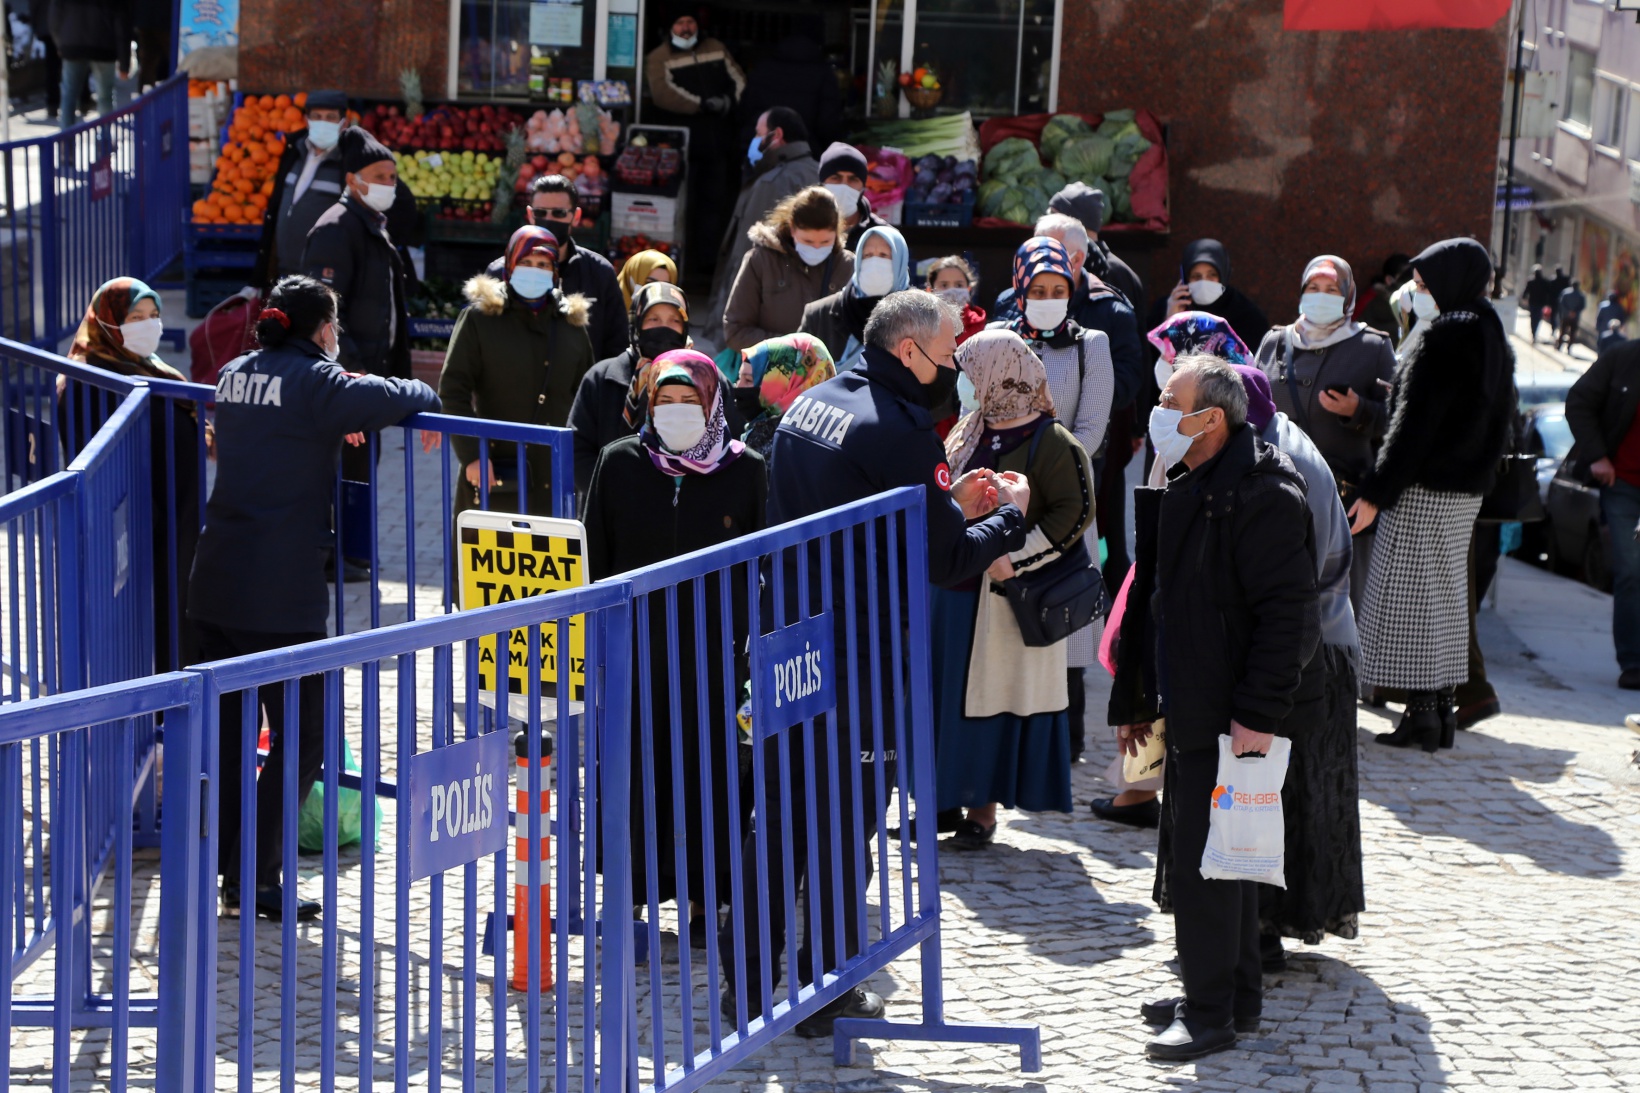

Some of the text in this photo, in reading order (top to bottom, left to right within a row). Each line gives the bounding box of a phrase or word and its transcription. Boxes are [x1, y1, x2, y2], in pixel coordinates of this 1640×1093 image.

[780, 395, 855, 446] ZABITA
[471, 547, 577, 583] MURAT
[774, 641, 822, 708] POLİS
[430, 762, 493, 842] POLİS
[1234, 792, 1279, 804] REHBER
